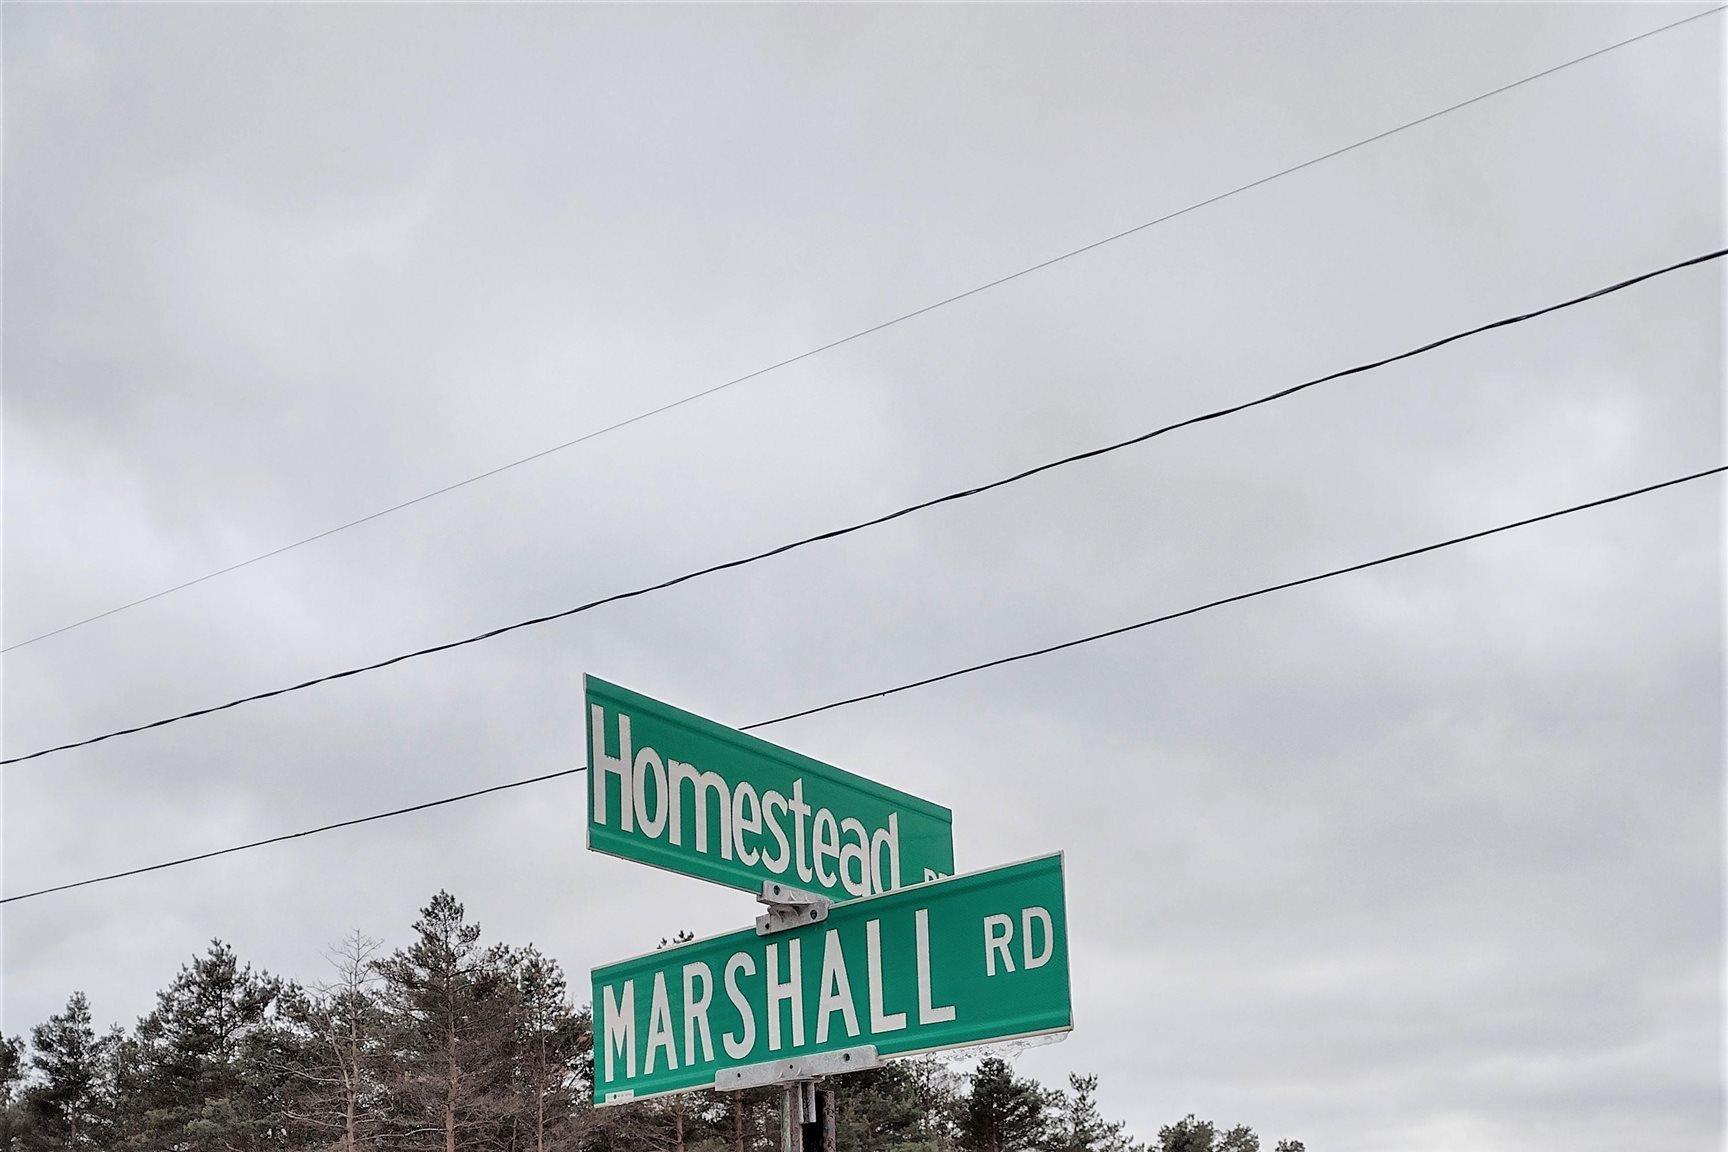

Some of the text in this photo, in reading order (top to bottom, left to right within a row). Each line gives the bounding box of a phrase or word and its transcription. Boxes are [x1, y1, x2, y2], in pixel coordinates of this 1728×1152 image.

[590, 703, 901, 897] Homestead
[603, 906, 1054, 1083] MARSHALL RD
